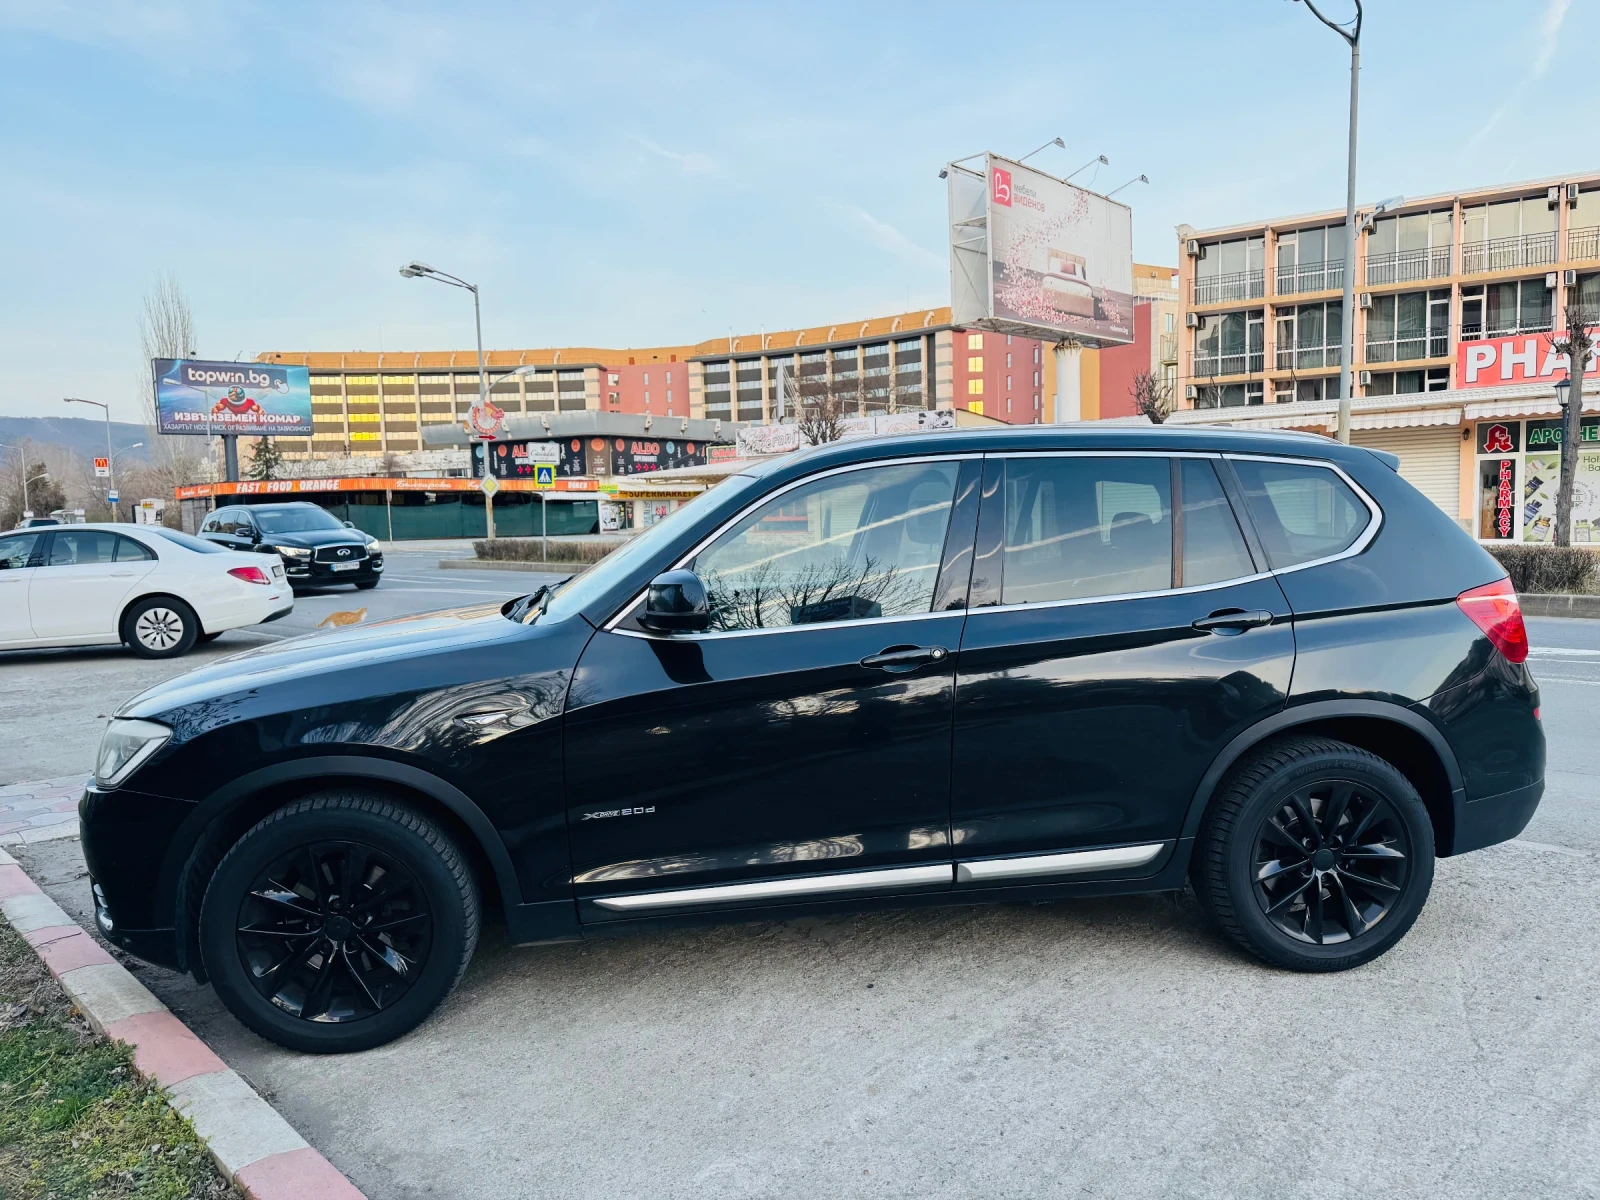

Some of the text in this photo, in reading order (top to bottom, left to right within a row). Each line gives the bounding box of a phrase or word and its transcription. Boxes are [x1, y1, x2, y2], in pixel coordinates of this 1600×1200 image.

[187, 367, 271, 387] topwin.bg
[174, 411, 301, 424] ИЗВЪНЗЕМЕН КОМАР
[630, 441, 660, 455] ALDO
[236, 479, 340, 493] FAST FOOD ORANGE
[1498, 460, 1511, 537] PHARMACY
